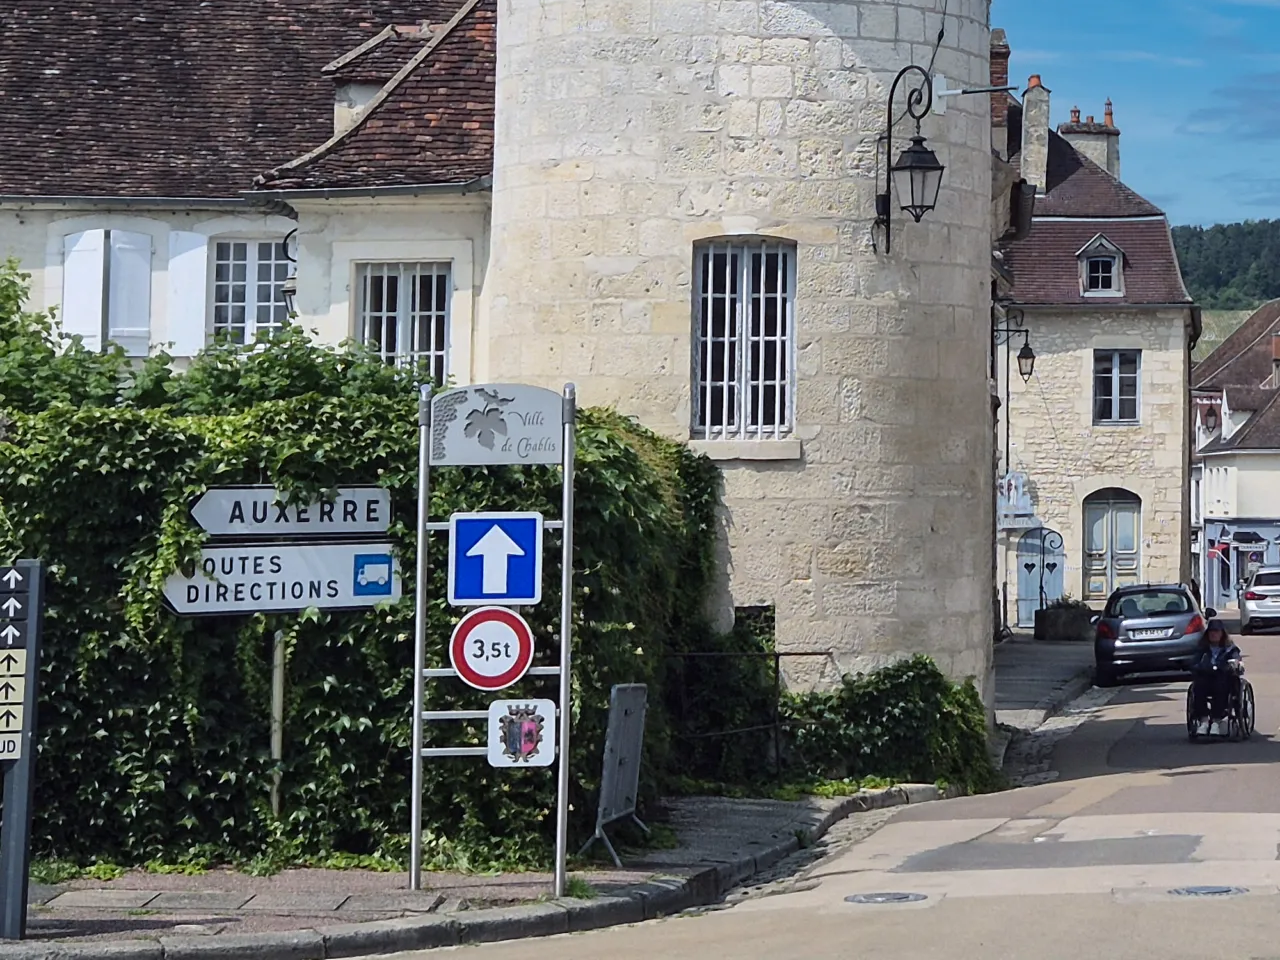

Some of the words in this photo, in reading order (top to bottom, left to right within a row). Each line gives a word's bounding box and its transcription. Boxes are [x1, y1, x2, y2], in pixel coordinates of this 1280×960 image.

[508, 411, 544, 426] Ville
[501, 437, 512, 452] de
[517, 436, 556, 458] Chablis
[228, 499, 380, 524] AUXERRE
[187, 555, 282, 576] OUTES
[187, 579, 339, 603] DIRECTIONS
[472, 638, 512, 661] 3,5t
